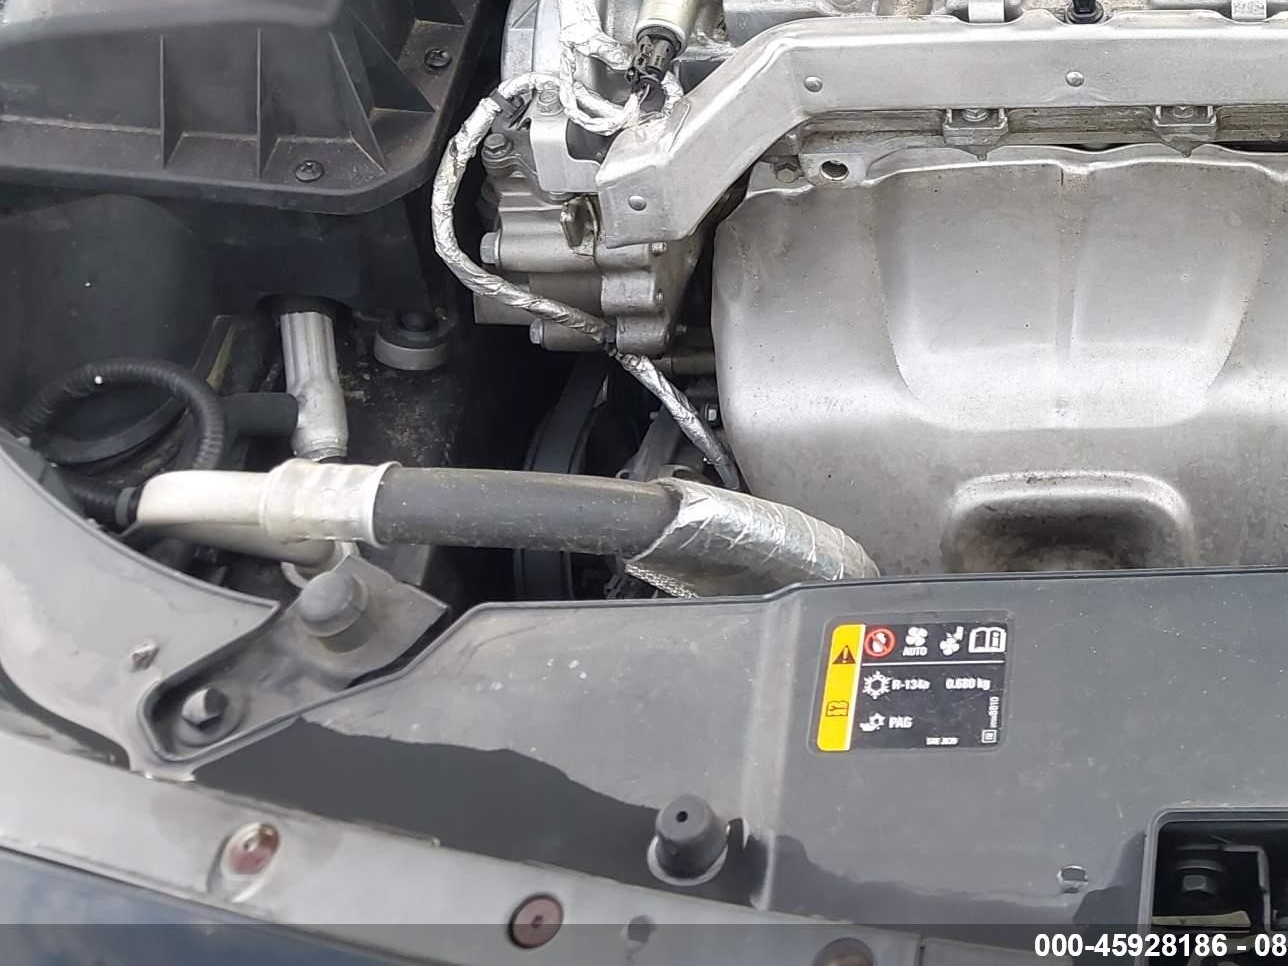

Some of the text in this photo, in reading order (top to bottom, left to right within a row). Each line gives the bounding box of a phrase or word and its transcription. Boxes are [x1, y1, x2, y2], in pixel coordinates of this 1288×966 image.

[903, 646, 928, 656] AUTO
[976, 677, 991, 691] kg
[889, 716, 913, 729] PAG
